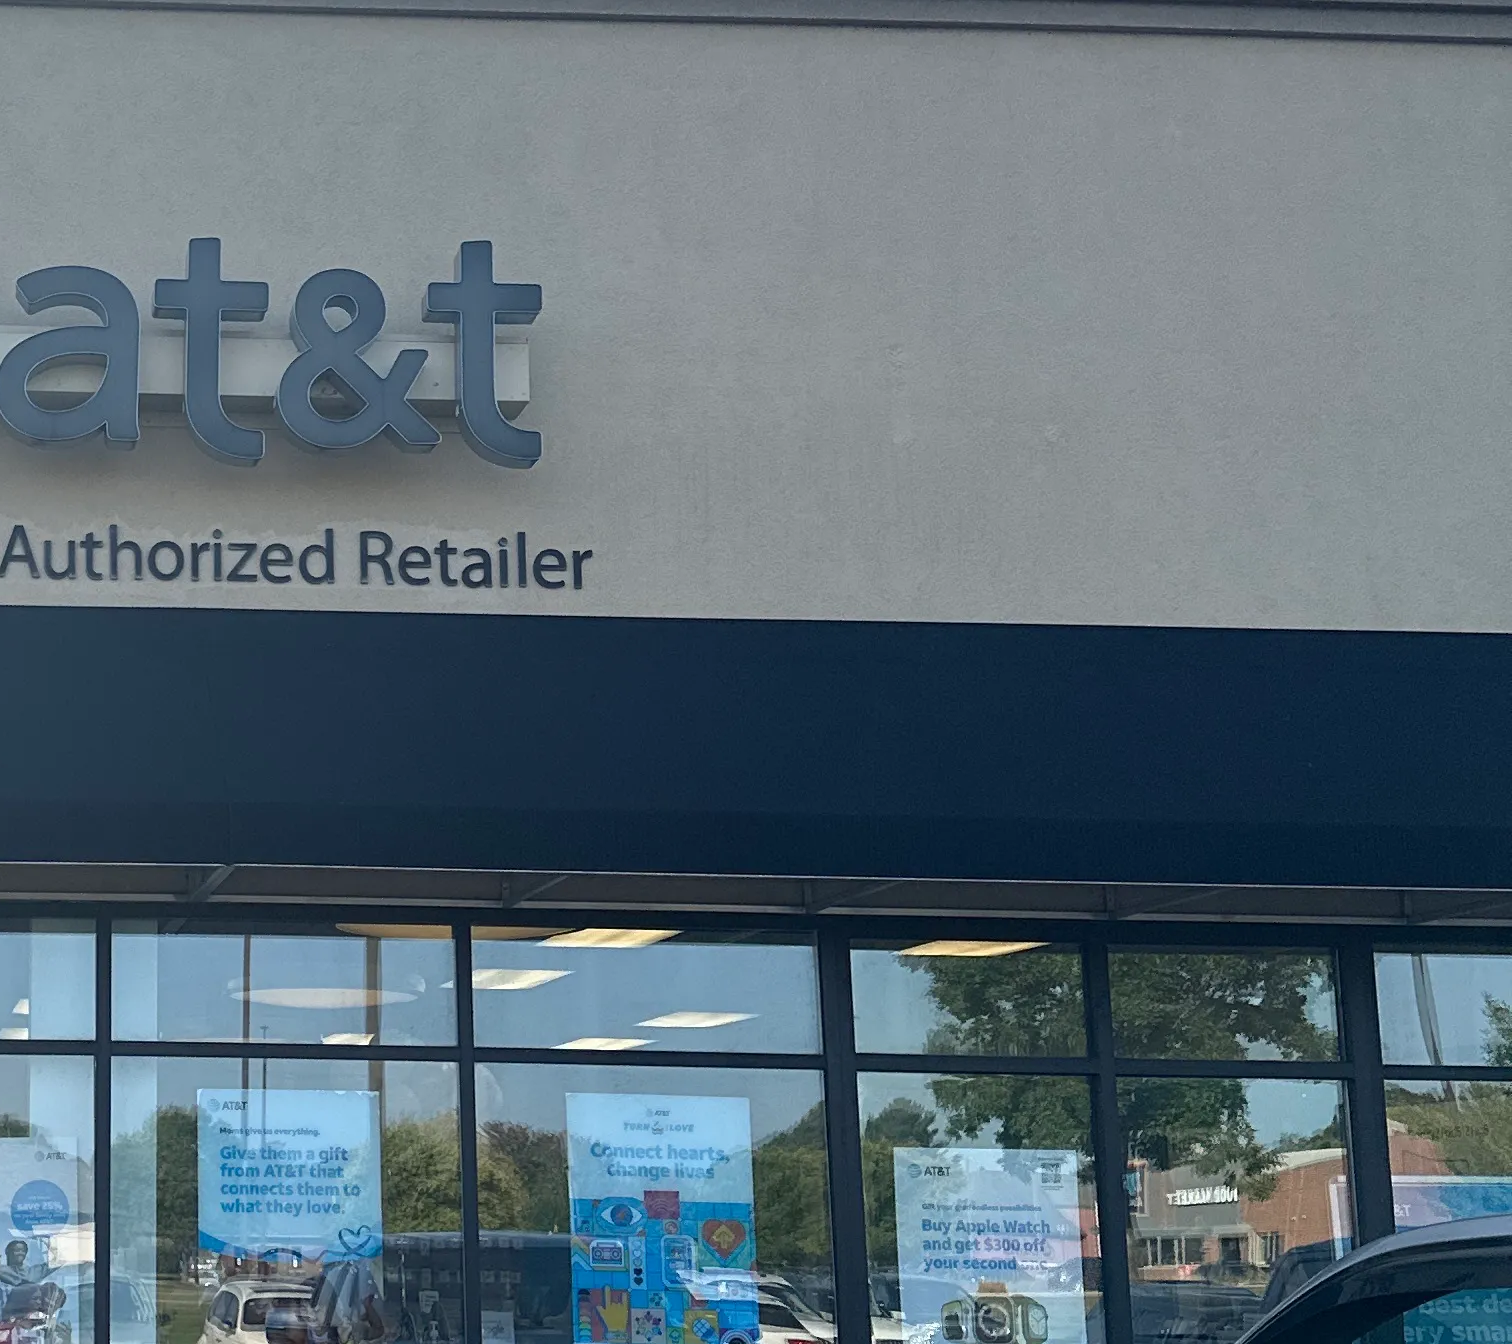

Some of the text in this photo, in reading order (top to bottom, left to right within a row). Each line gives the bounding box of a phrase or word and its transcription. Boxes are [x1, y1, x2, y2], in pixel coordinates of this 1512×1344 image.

[359, 530, 593, 591] Retailer
[222, 1101, 248, 1111] AT&T
[274, 1128, 320, 1137] everything.
[669, 1124, 695, 1133] LOVE
[220, 1146, 348, 1164] Give them a gift
[590, 1142, 730, 1164] Connect hearts,
[220, 1163, 345, 1178] from AT&T that
[607, 1162, 715, 1181] change lives
[924, 1166, 950, 1177] AT&T
[220, 1181, 361, 1197] connects them to
[220, 1199, 345, 1217] what they love.
[922, 1219, 1051, 1236] Buy Apple Watch
[922, 1237, 1047, 1254] and get $300 off
[924, 1258, 958, 1272] your
[963, 1256, 1017, 1271] second
